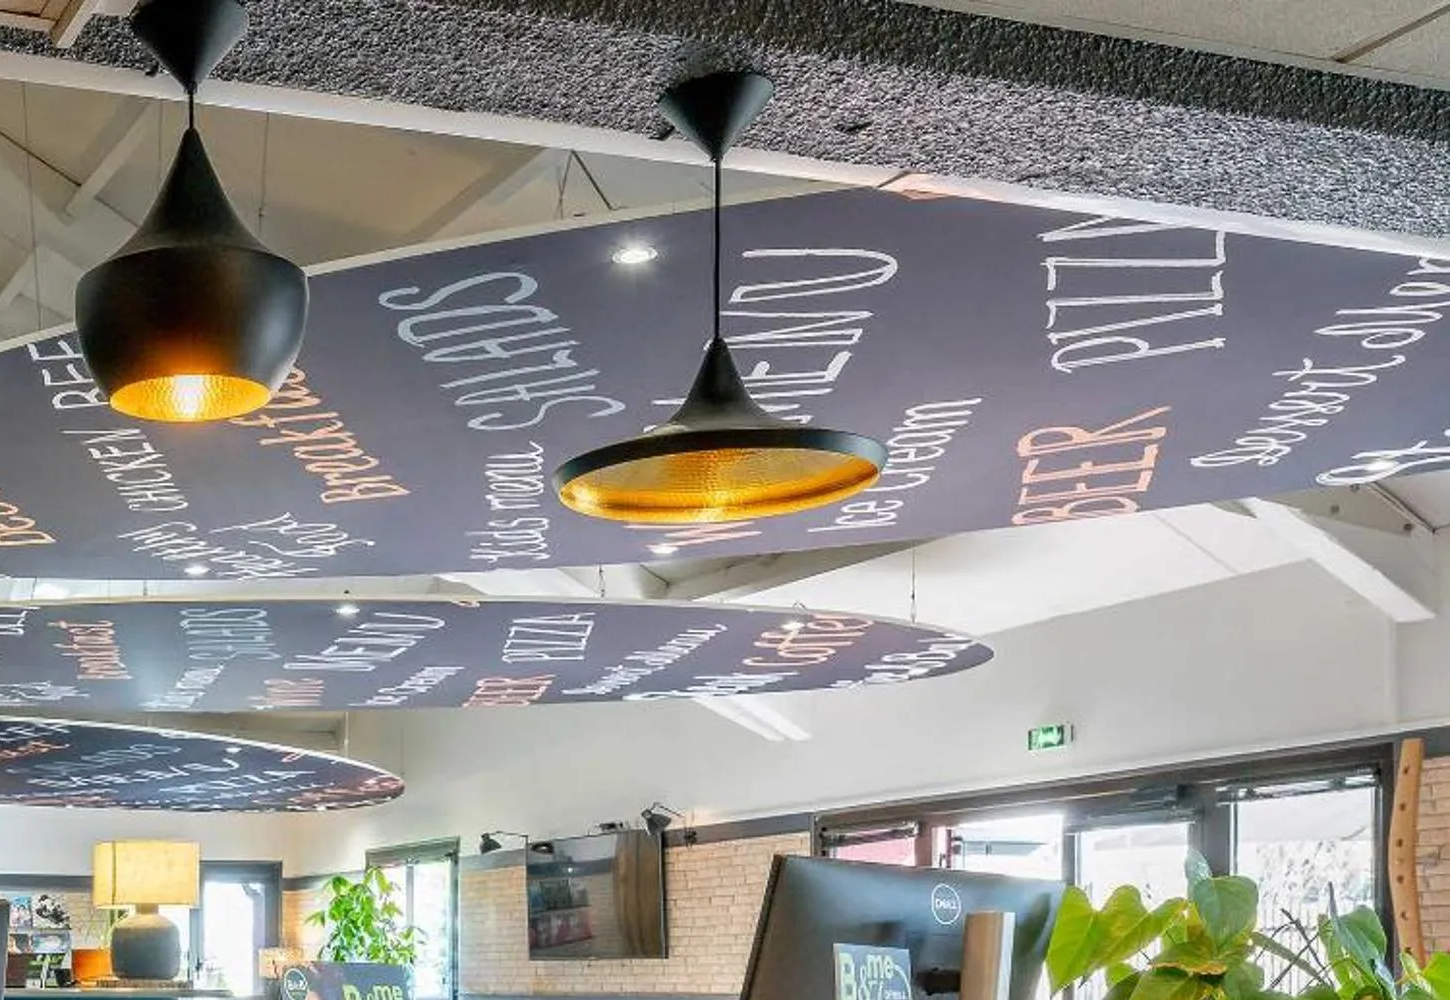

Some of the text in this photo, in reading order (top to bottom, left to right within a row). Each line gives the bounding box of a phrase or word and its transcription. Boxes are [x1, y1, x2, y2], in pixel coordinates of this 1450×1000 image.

[378, 270, 626, 432] SALADS
[1012, 405, 1173, 526] BEER
[1190, 355, 1407, 467] Dessert
[60, 427, 190, 512] CHICKEN
[501, 612, 597, 664] PIZZA
